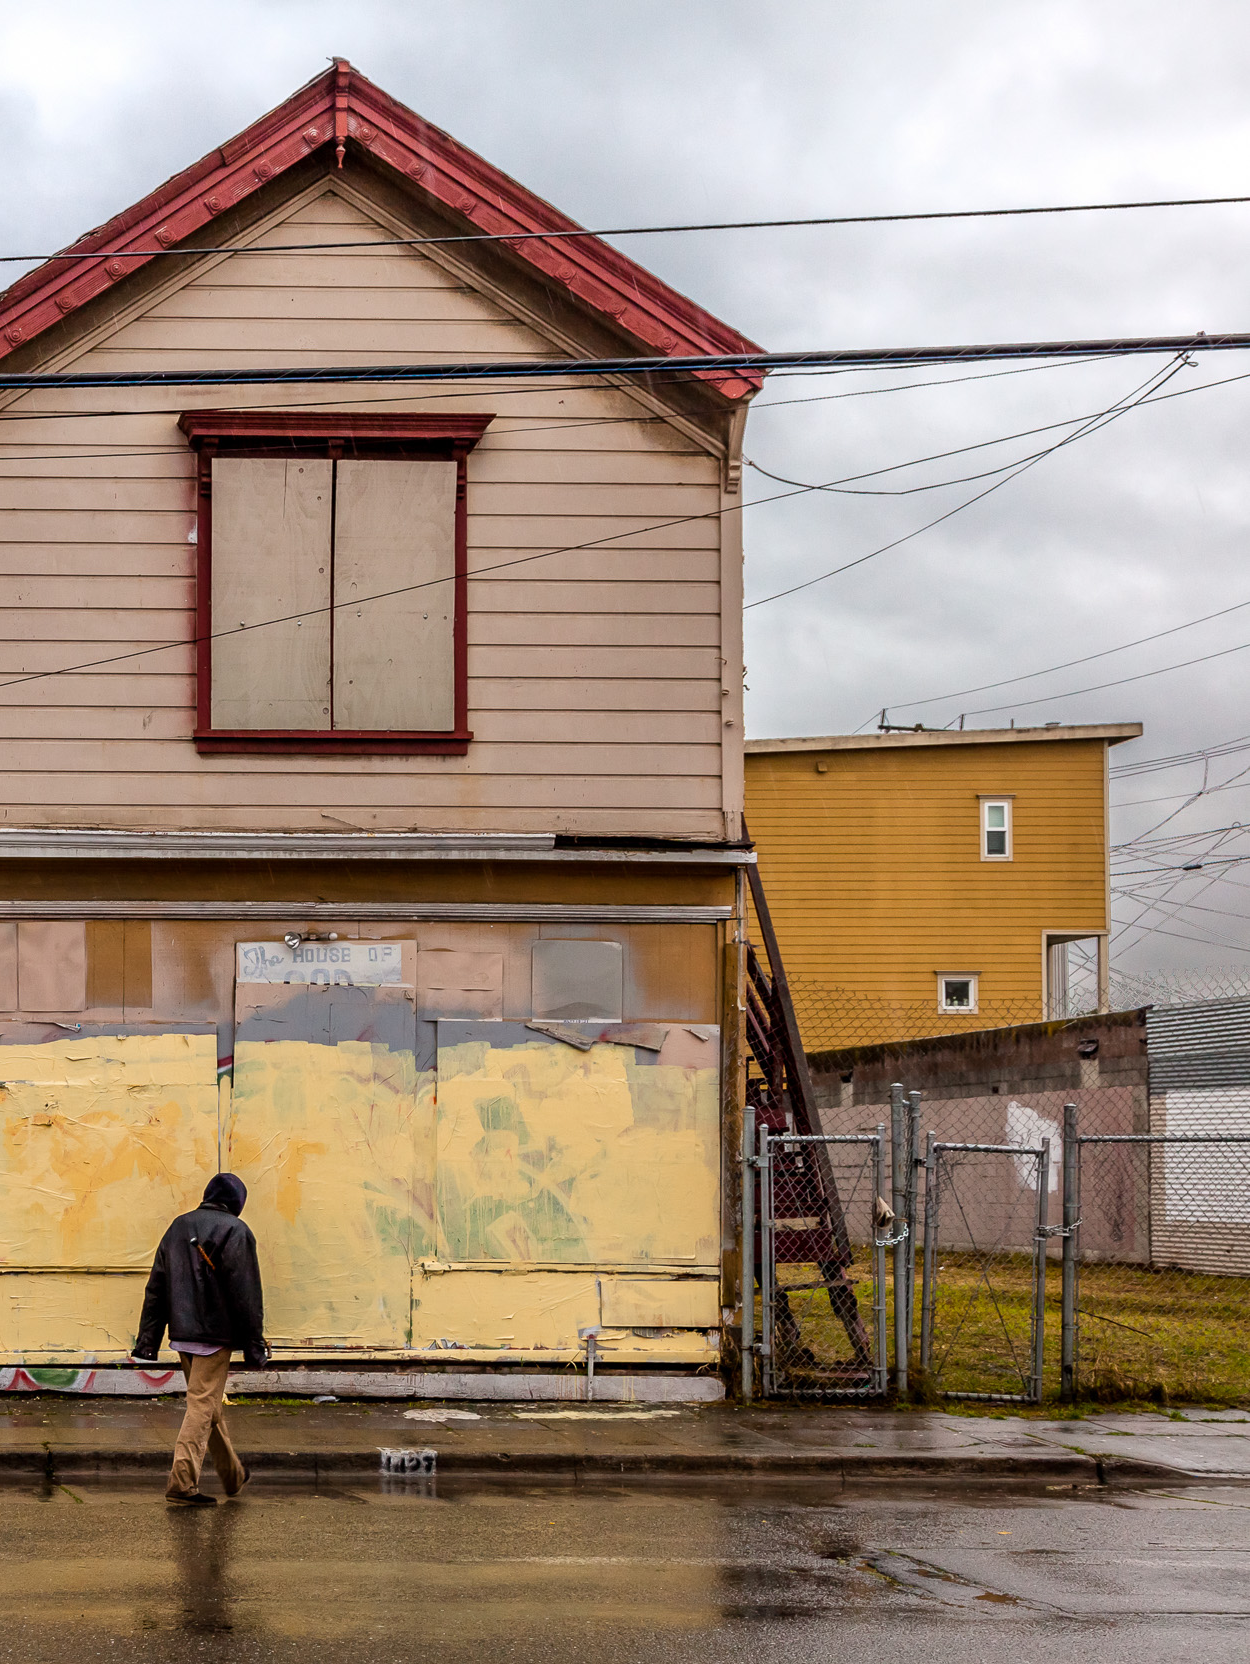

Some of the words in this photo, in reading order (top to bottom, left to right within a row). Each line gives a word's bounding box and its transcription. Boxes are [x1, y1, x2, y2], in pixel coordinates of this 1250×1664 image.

[243, 945, 284, 978] The
[292, 947, 351, 963] HOUSE
[368, 946, 393, 962] OF
